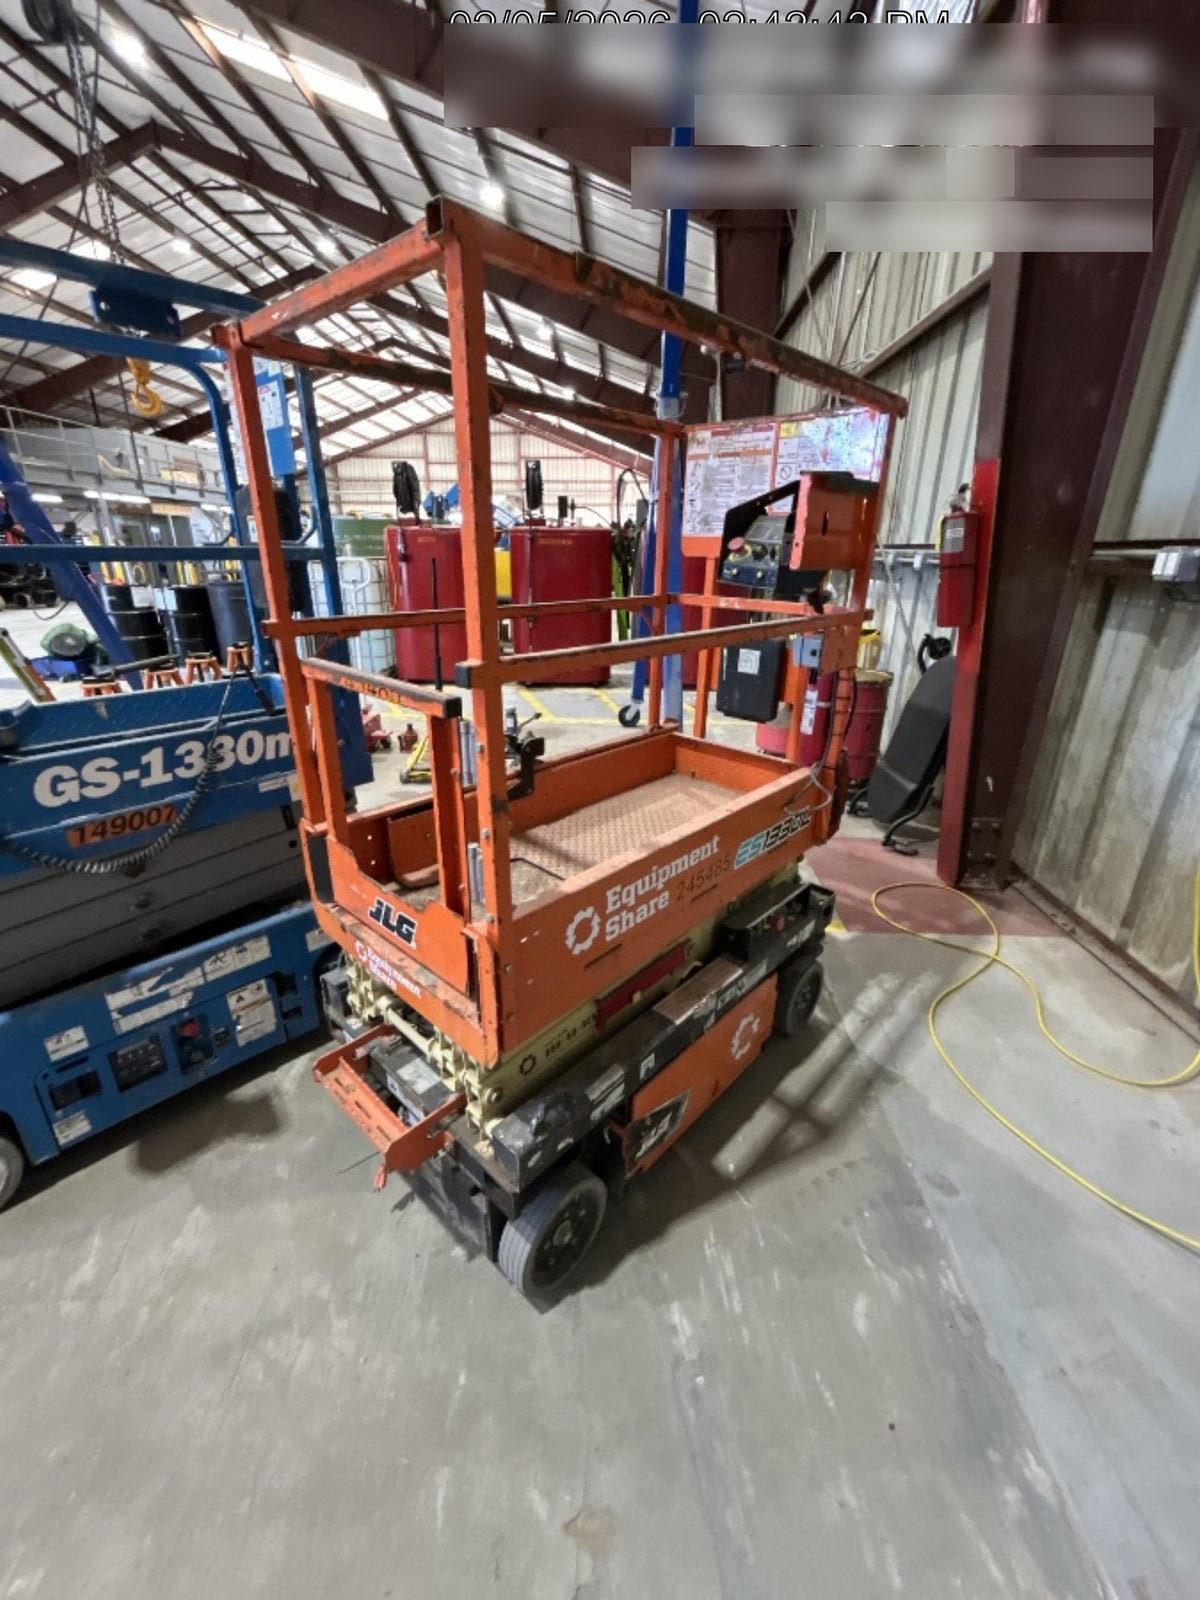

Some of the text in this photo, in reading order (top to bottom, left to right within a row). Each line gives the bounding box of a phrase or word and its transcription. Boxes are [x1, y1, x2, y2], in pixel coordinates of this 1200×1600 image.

[73, 803, 175, 844] 149007
[605, 835, 720, 914] Equipment
[368, 897, 417, 946] JLG
[605, 890, 669, 942] Share
